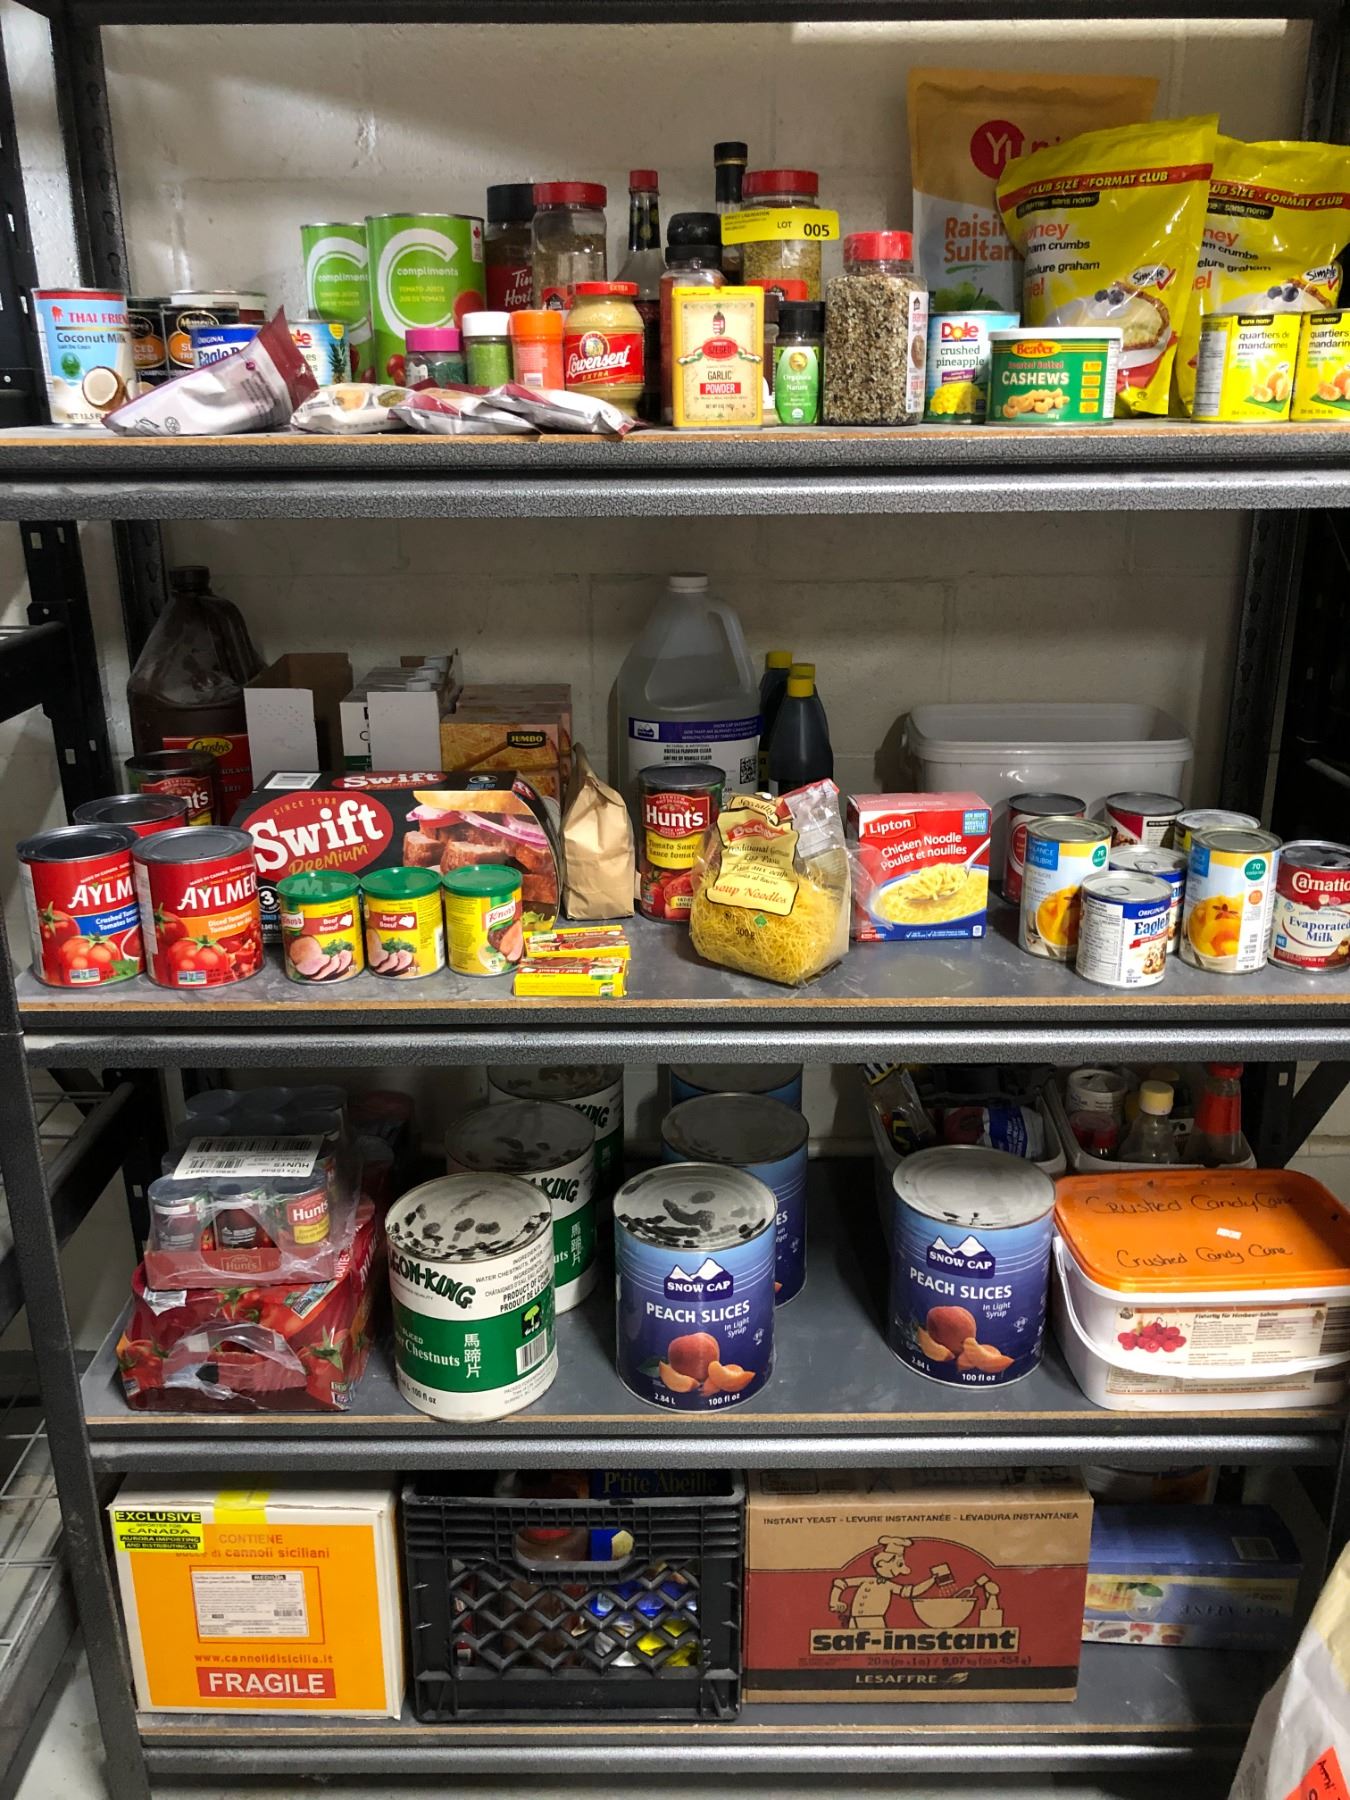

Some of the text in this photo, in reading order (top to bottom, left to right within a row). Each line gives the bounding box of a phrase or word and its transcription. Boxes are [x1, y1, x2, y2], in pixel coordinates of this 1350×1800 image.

[1055, 179, 1079, 190] SIZE
[1089, 175, 1136, 187] FORMAT
[1139, 171, 1168, 183] CLUB
[1230, 184, 1343, 207] SIZE FORMAT CLUB
[777, 221, 792, 229] LOT
[804, 223, 830, 237] 005
[1204, 228, 1239, 247] ney
[1049, 240, 1090, 251] crumbs
[1218, 245, 1258, 260] crumbs
[397, 267, 459, 278] compliments
[1058, 261, 1100, 276] graham
[318, 273, 368, 284] compliment
[505, 289, 532, 308] Hort
[68, 312, 98, 323] THAI
[56, 332, 127, 344] Coconut Milk
[941, 322, 979, 340] Dole
[1239, 332, 1281, 342] quartiers
[940, 345, 981, 356] crushed
[936, 356, 985, 370] pineapple
[582, 371, 609, 381] EXTRA
[707, 370, 732, 381] GARLIC
[1001, 371, 1070, 386] CASHEWS
[705, 383, 735, 394] POWDER
[510, 734, 543, 743] JUMBO
[191, 740, 232, 753] Crosby's
[343, 771, 440, 788] Swift
[273, 800, 304, 816] SINCE
[869, 819, 911, 835] Lipton
[248, 800, 384, 874] Swift
[649, 839, 674, 850] Tomato
[881, 832, 962, 858] Chicken Noodle
[670, 851, 695, 859] tomat
[880, 845, 967, 871] Poulet et nouilles
[67, 876, 134, 909] AYLM
[743, 886, 787, 904] Noodles
[96, 912, 122, 925] Crushed
[1138, 906, 1165, 917] ORIGINAL
[99, 920, 126, 931] Tomates
[208, 917, 228, 927] Diced
[323, 917, 338, 925] Beef
[1134, 912, 1164, 936] Eagle
[735, 927, 749, 937] 500
[1306, 931, 1333, 942] Milk
[1085, 1191, 1295, 1214] Crushed Candy Cane
[929, 1251, 993, 1270] SNOW CAP
[1116, 1243, 1294, 1268] Crushed Candy Cane
[475, 1274, 496, 1283] WATER
[910, 1266, 1012, 1300] PEACH SLICES
[503, 1279, 537, 1302] PRODUCT OF
[667, 1280, 731, 1293] SNOW CAP
[500, 1286, 541, 1312] PRODUIT DE LA
[646, 1300, 750, 1323] PEACH SLICES
[982, 1302, 1011, 1312] In Light
[985, 1310, 1007, 1319] Syrup
[724, 1316, 750, 1331] In Light
[402, 1327, 424, 1345] SLICED
[727, 1325, 747, 1339] Syrup
[405, 1339, 461, 1367] Chestnuts
[464, 1333, 482, 1378] 馬蹄片
[911, 1357, 925, 1370] 2.84
[926, 1364, 931, 1372] L
[961, 1373, 976, 1381] 100
[978, 1373, 985, 1381] fl
[654, 1392, 670, 1404] 2.84
[708, 1397, 723, 1406] 100
[723, 1395, 730, 1403] fl
[731, 1393, 741, 1402] oz
[115, 1511, 201, 1523] EXCLUSIVE
[763, 1516, 804, 1526] INSTANT
[806, 1516, 837, 1525] YEAST
[846, 1515, 884, 1525] LEVURE
[885, 1513, 951, 1523] INSTANTANÉE
[959, 1512, 1011, 1522] LEVADURA
[127, 1527, 190, 1535] CANADA
[218, 1533, 284, 1545] CONTIENE
[278, 1547, 330, 1559] siciliani
[813, 1630, 1016, 1652] saf-instant
[208, 1672, 326, 1694] FRAGILE
[855, 1674, 938, 1685] LESAFFRE
